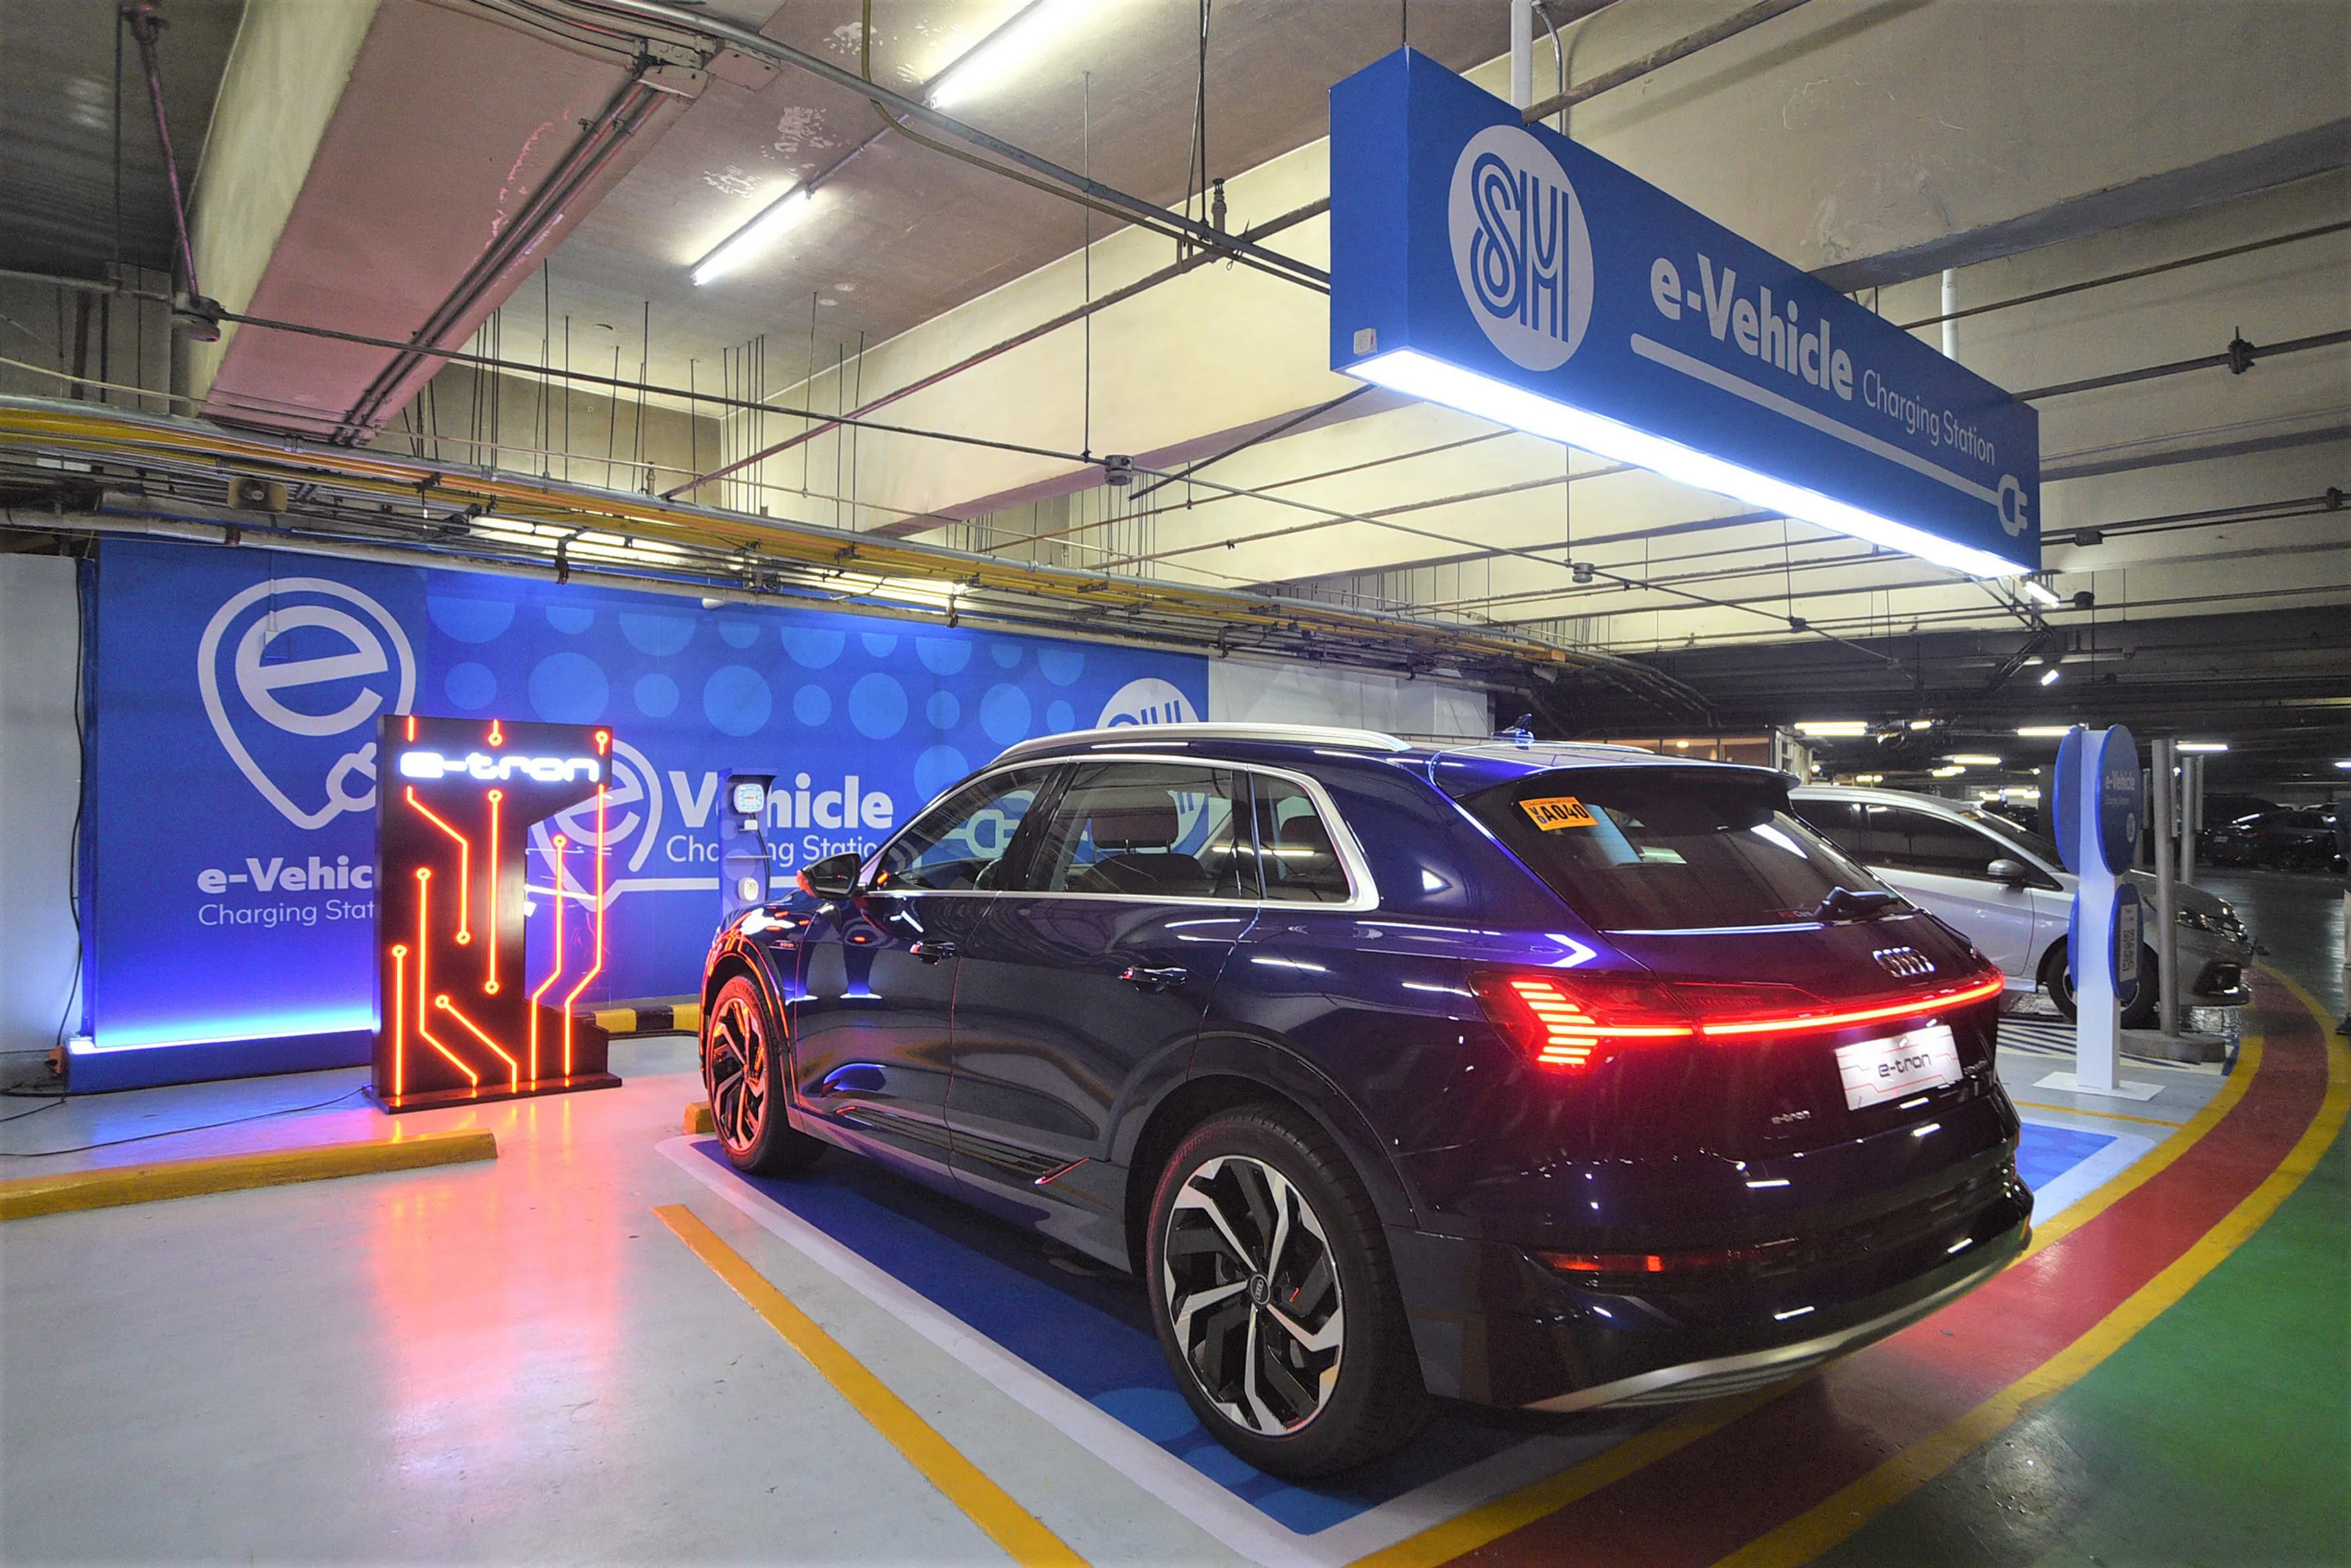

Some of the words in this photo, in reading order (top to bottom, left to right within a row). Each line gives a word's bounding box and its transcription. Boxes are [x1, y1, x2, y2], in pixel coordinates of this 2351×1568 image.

[1470, 152, 1569, 343] SM
[1650, 252, 1854, 401] e-Vehicle
[1863, 369, 1940, 446] Charging
[1943, 410, 1995, 466] Station
[399, 751, 600, 783] e-tron
[668, 771, 894, 830] Vhicle
[666, 835, 794, 868] Chang
[803, 835, 878, 861] Statio
[197, 855, 373, 894] e-Vehic
[198, 902, 317, 928] Charging
[326, 899, 374, 920] Stat
[1878, 1054, 1932, 1078] e-tron
